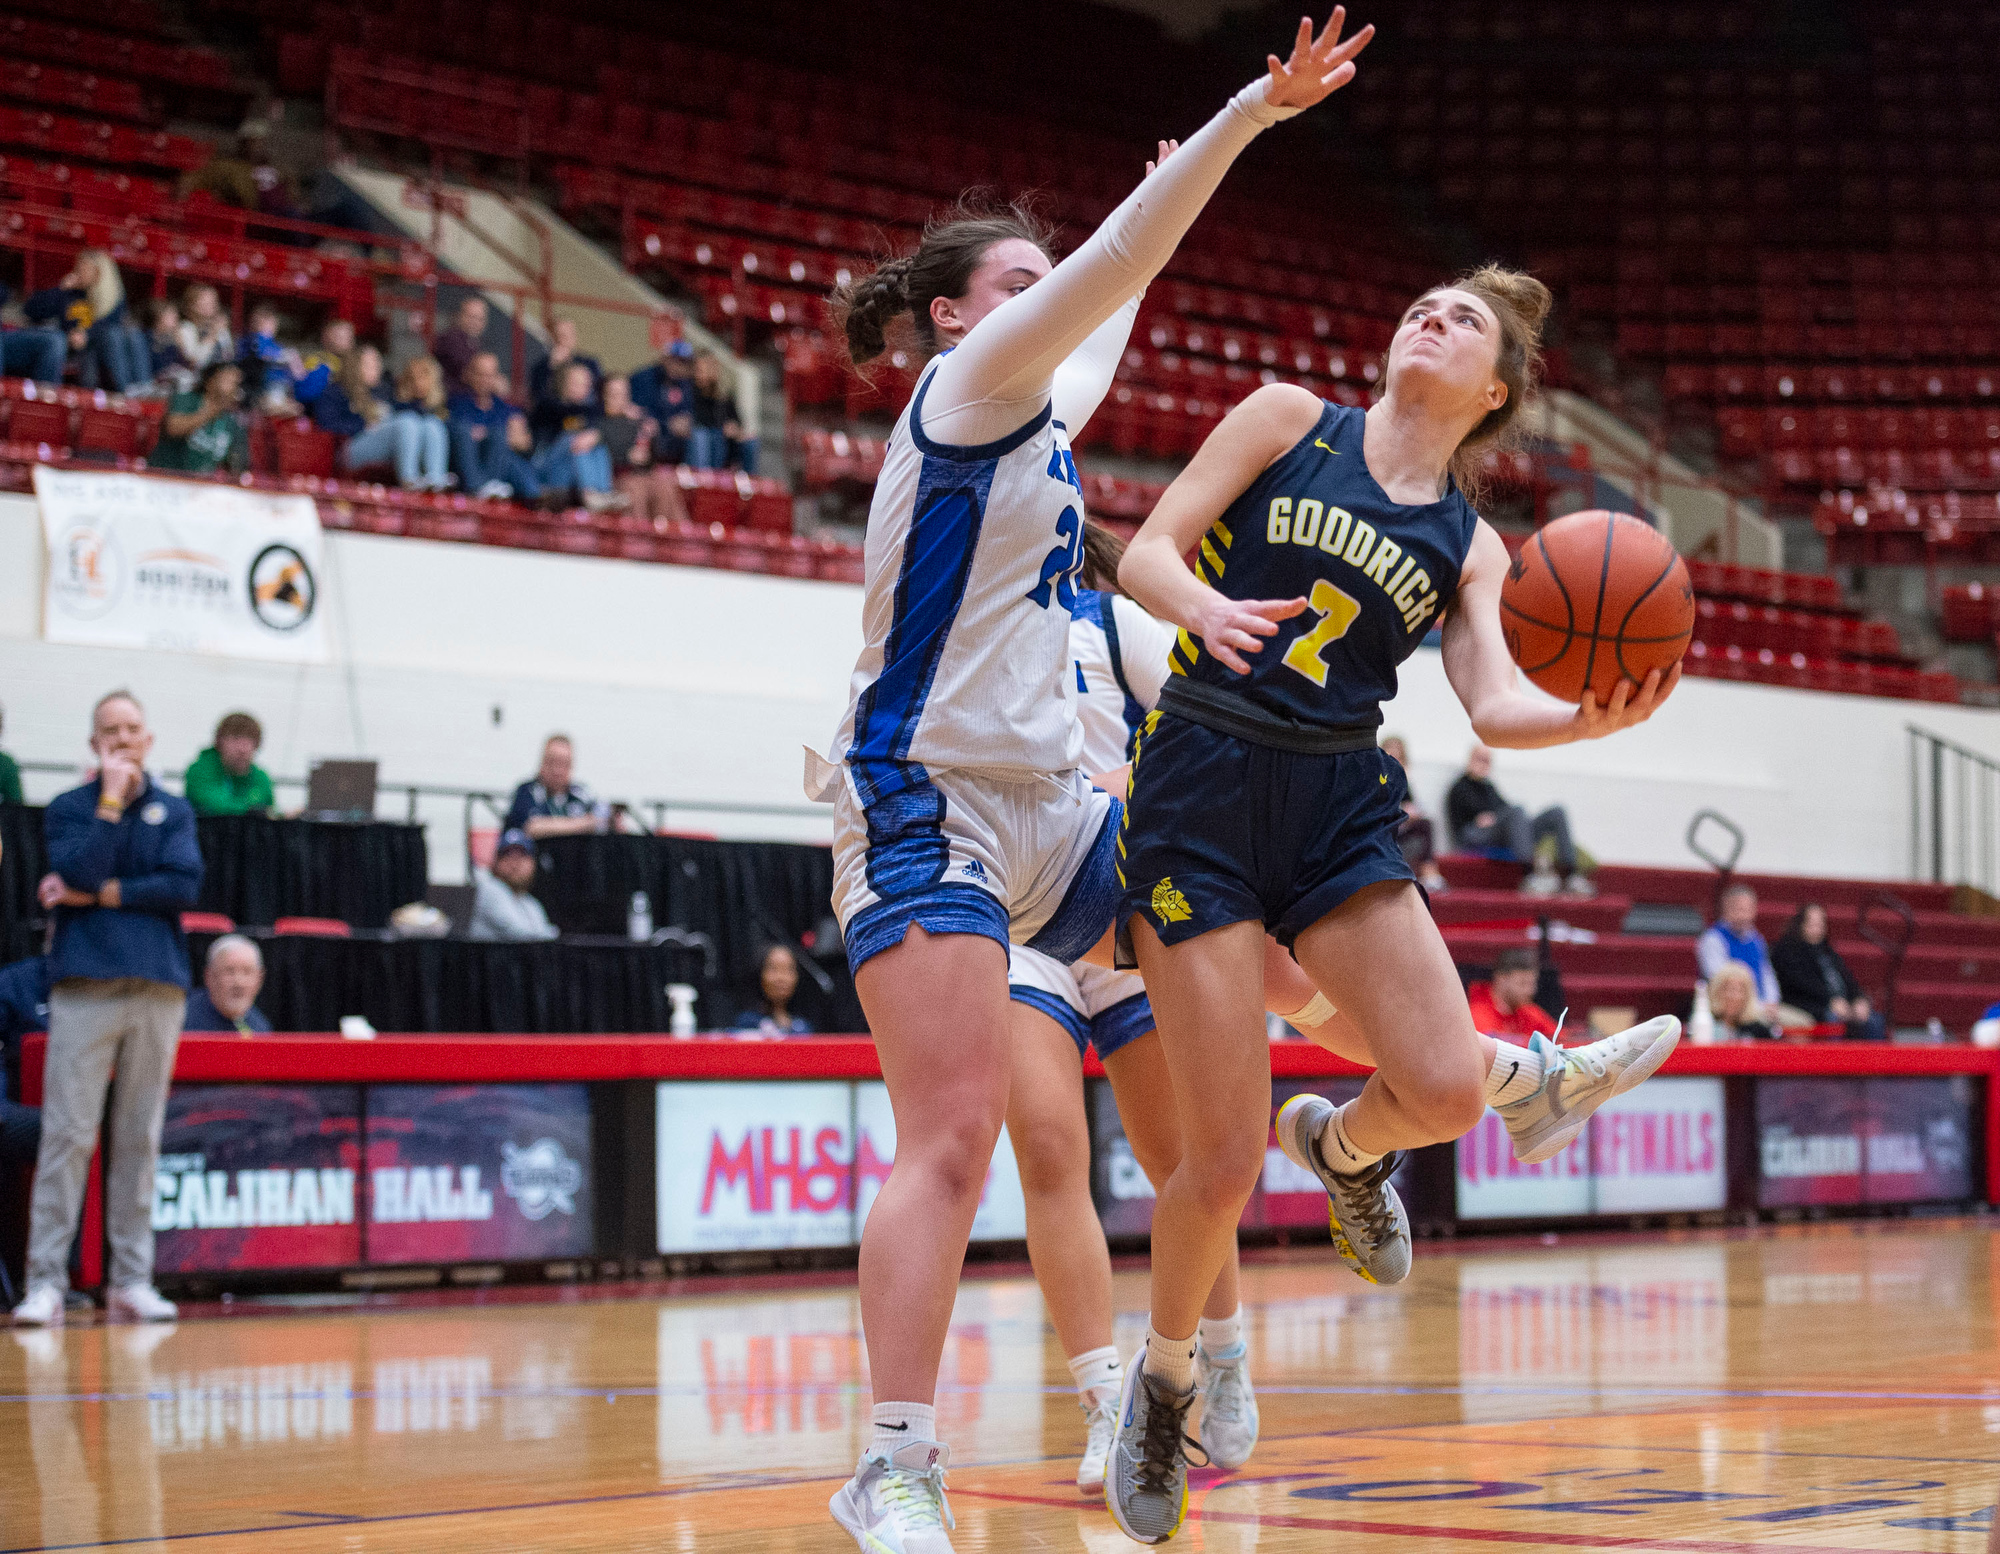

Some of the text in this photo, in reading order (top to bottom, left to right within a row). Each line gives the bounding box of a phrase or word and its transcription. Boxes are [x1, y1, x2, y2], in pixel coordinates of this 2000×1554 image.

[1267, 497, 1438, 634] GOODRICH
[961, 868, 989, 884] adidas
[152, 1165, 493, 1230] CALIHAN HALL
